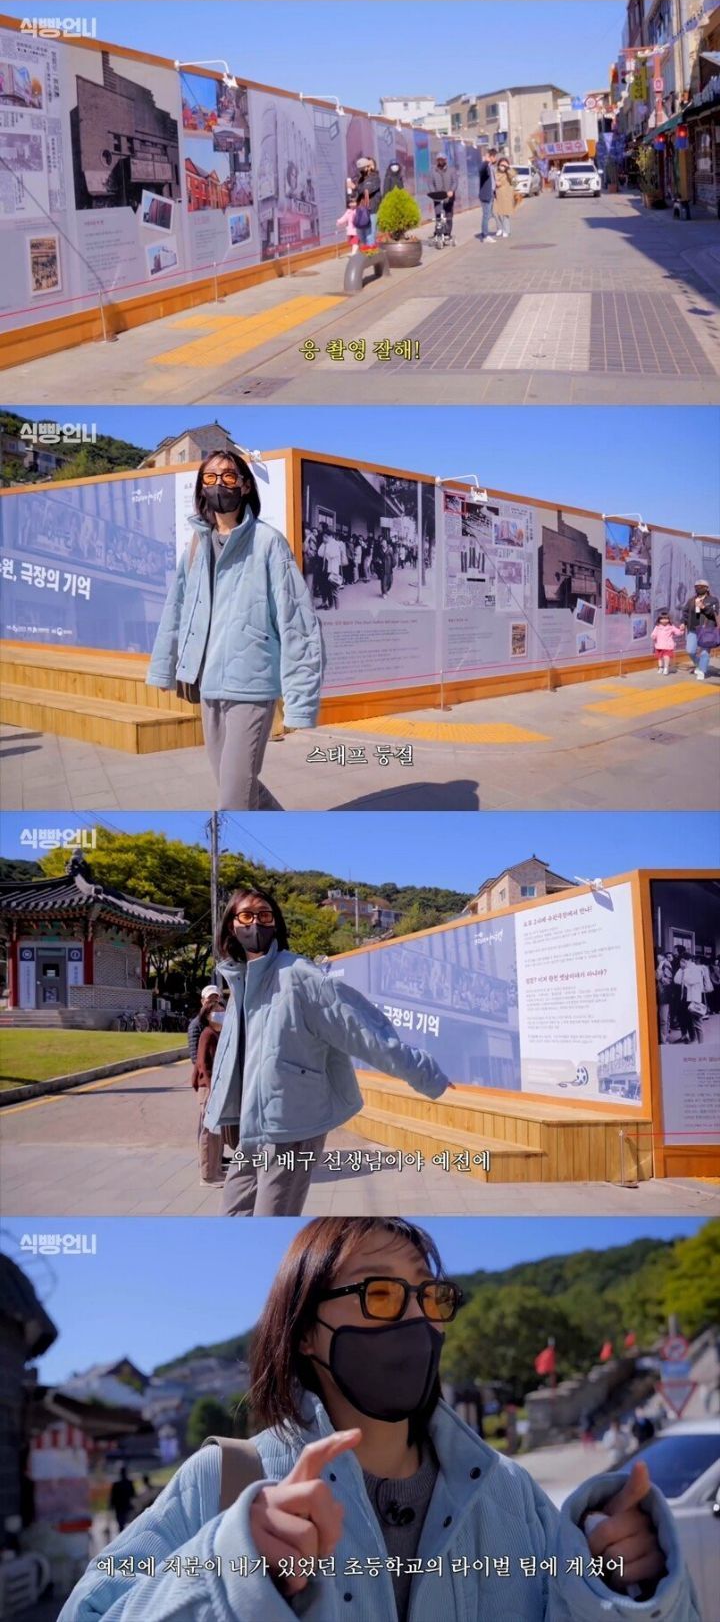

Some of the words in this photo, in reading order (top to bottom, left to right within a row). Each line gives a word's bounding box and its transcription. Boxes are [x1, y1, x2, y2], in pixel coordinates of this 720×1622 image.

[0, 558, 17, 582] 원,
[20, 562, 60, 592] 극장의
[63, 573, 92, 600] 기억
[416, 1012, 440, 1037] 기억
